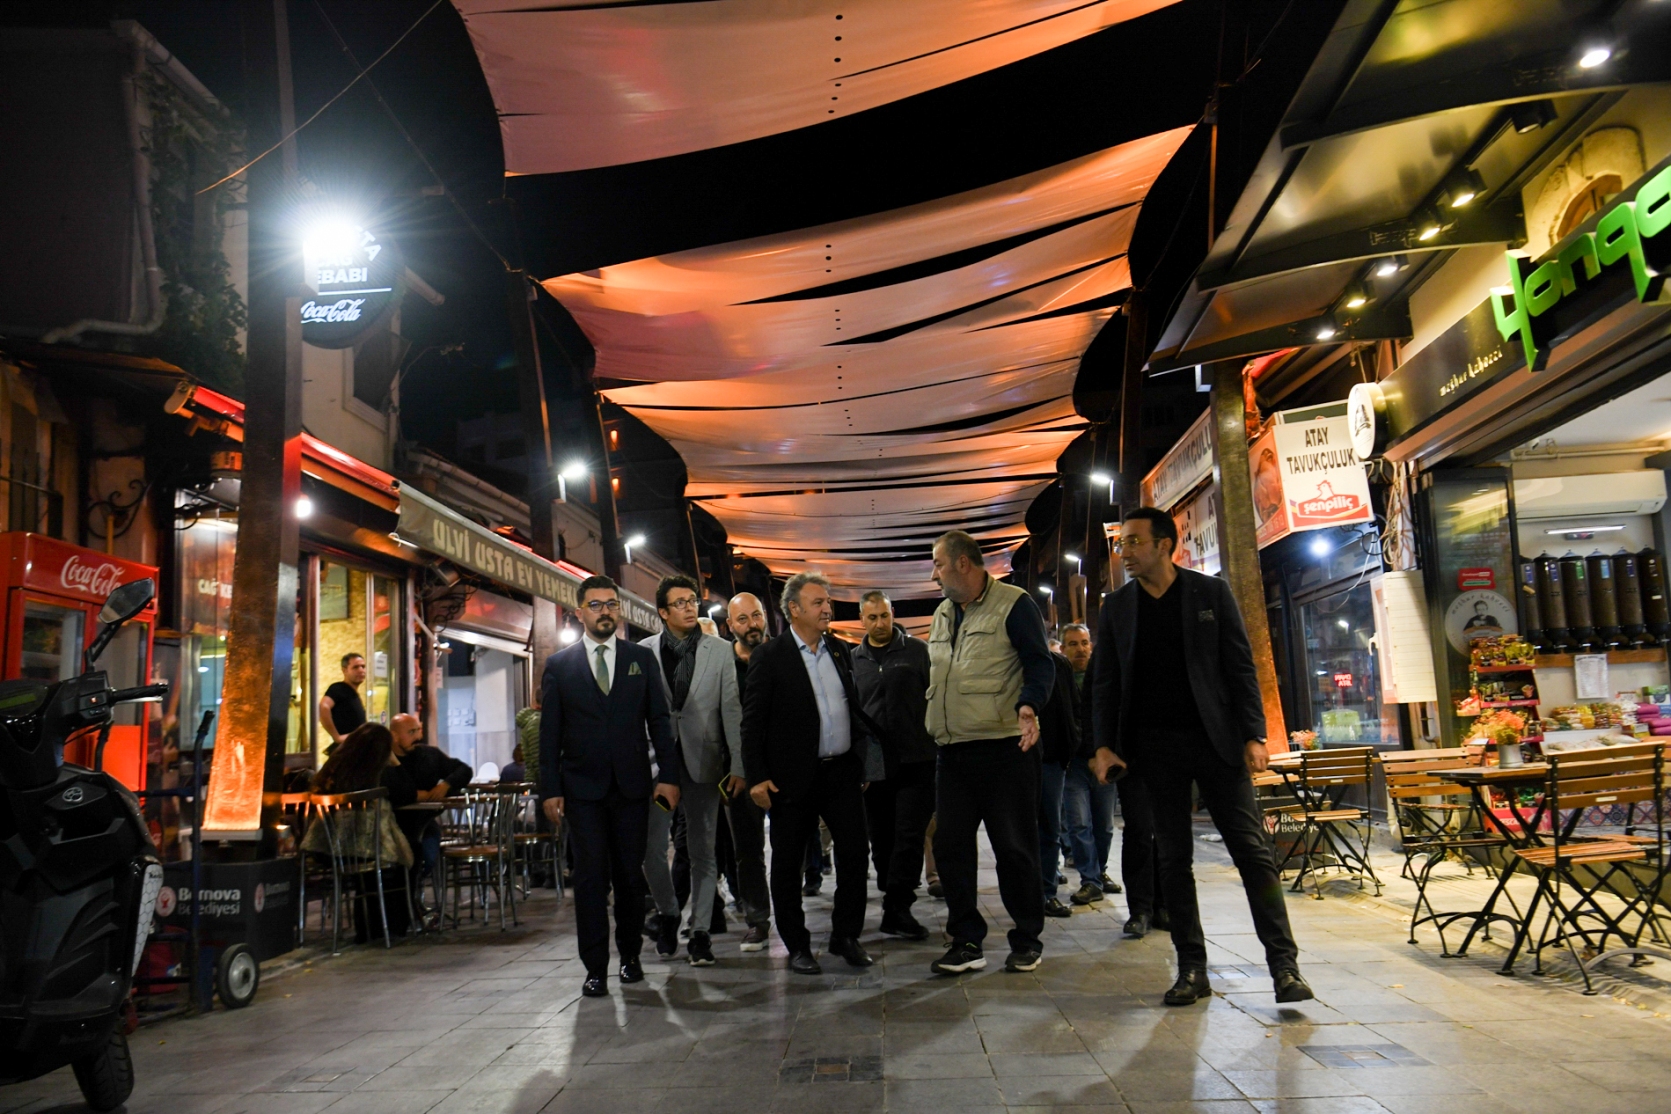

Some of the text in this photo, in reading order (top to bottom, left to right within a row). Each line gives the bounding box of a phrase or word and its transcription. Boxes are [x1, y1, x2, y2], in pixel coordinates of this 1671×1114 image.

[1305, 426, 1329, 448] ATAY
[1168, 422, 1212, 486] TAVUKÇULU
[1286, 448, 1356, 475] TAVUKÇULUK
[1304, 493, 1354, 515] şenpiliç
[432, 519, 579, 609] ULVİ USTA EV YEMEKL
[178, 901, 241, 918] Beediyesi
